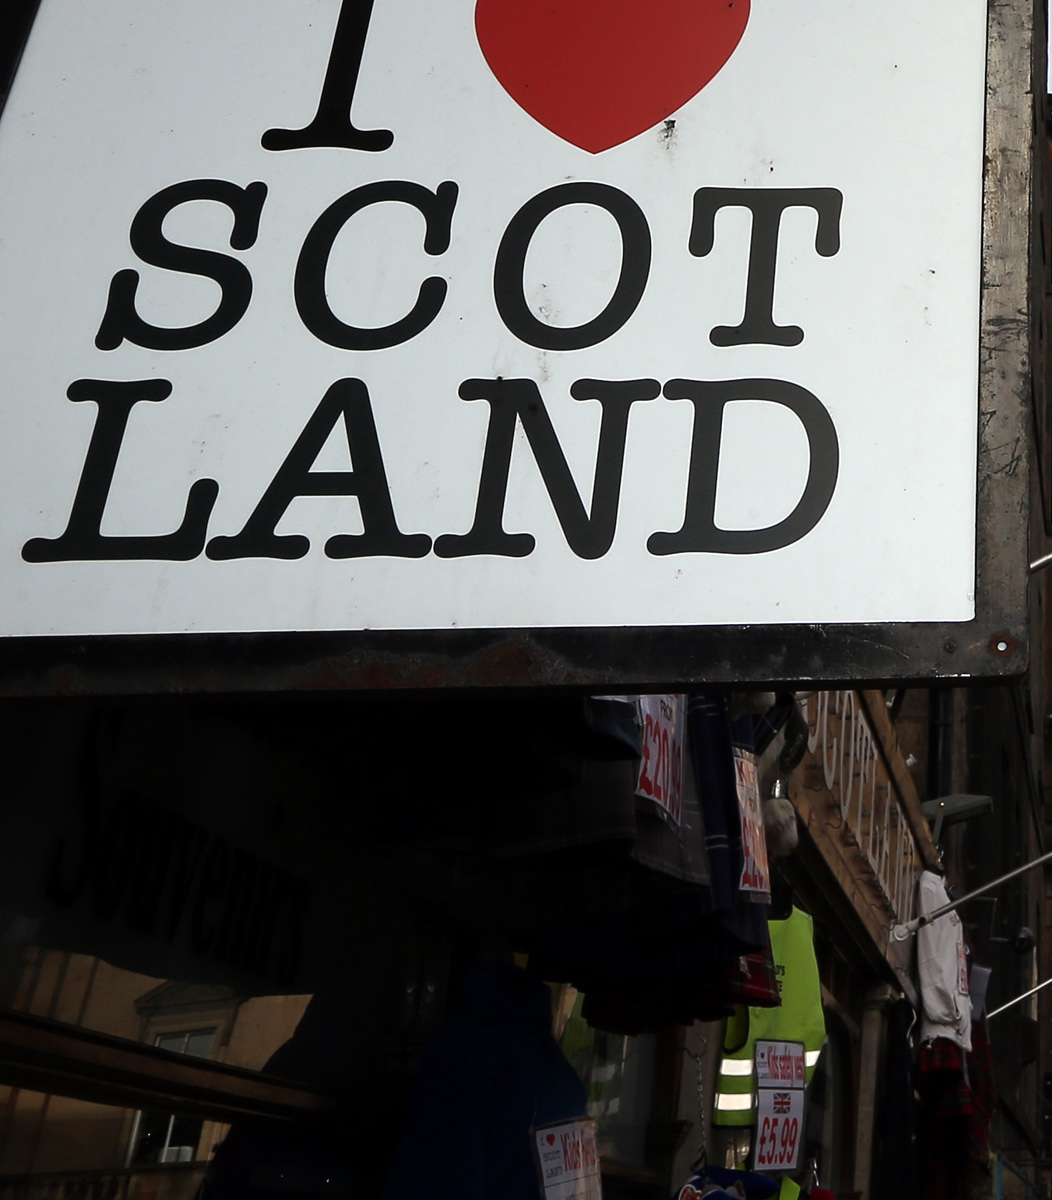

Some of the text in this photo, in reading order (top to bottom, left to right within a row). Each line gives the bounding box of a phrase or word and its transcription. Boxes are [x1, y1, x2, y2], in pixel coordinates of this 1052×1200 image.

[95, 179, 843, 351] SCOT
[22, 376, 839, 563] LAND
[757, 1116, 798, 1164] £5.99
